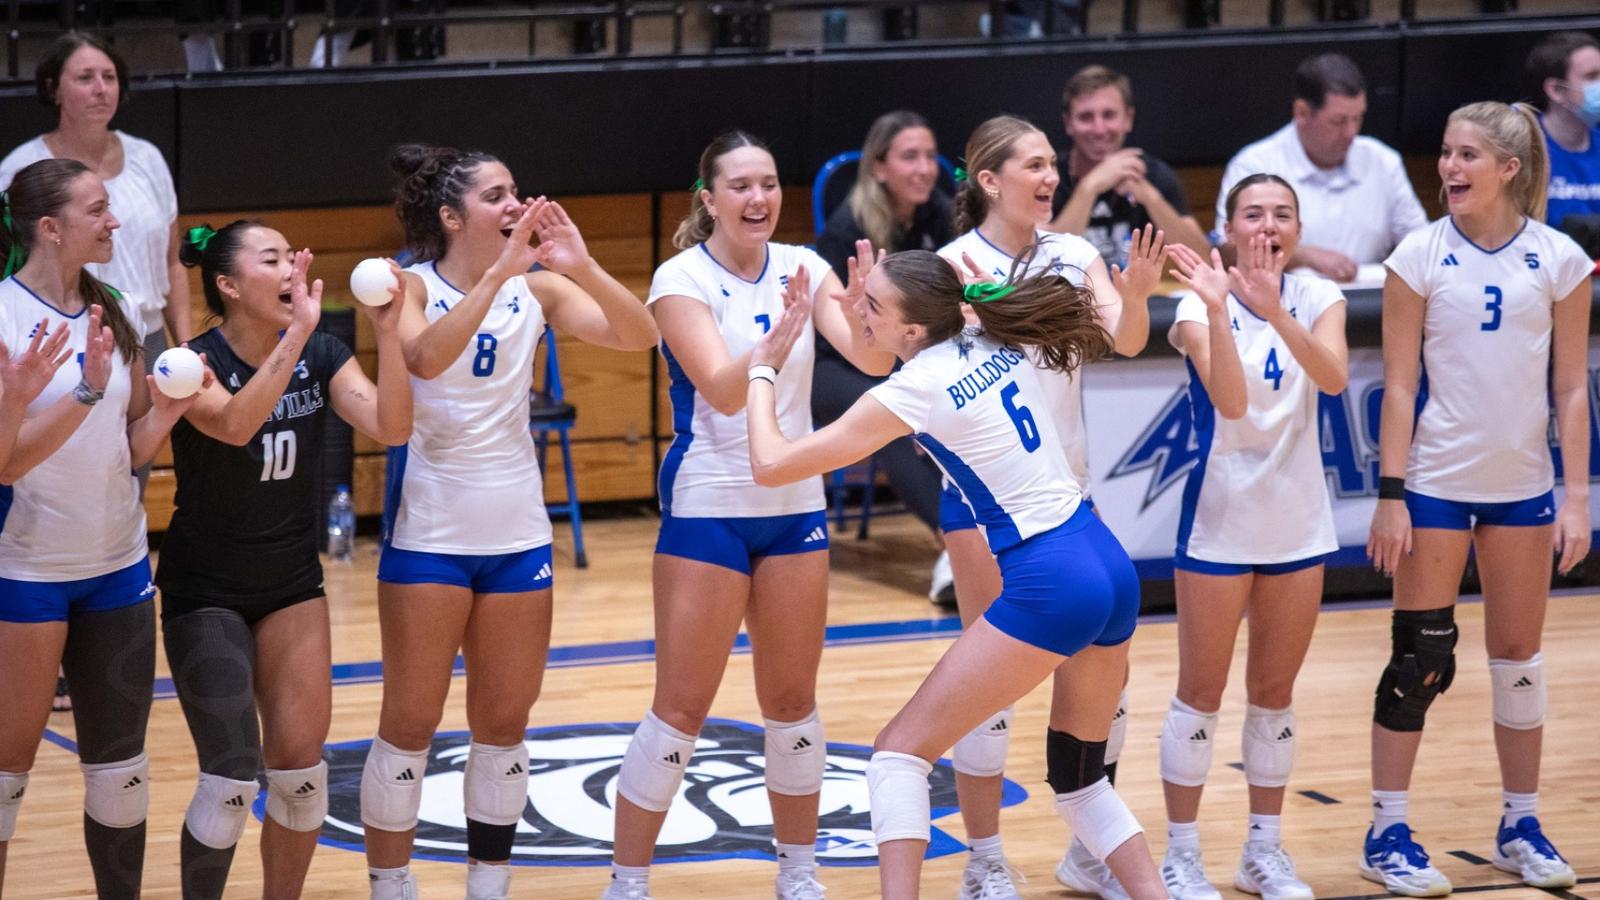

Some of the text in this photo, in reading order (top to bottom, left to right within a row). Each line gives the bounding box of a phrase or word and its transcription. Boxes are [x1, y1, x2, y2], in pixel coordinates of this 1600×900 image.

[1481, 286, 1503, 332] 3
[472, 333, 498, 378] 8
[946, 343, 1025, 411] BULLDOGS
[1264, 347, 1284, 391] 4
[267, 382, 325, 422] VILLE
[1000, 380, 1042, 454] 6
[260, 430, 297, 482] 10
